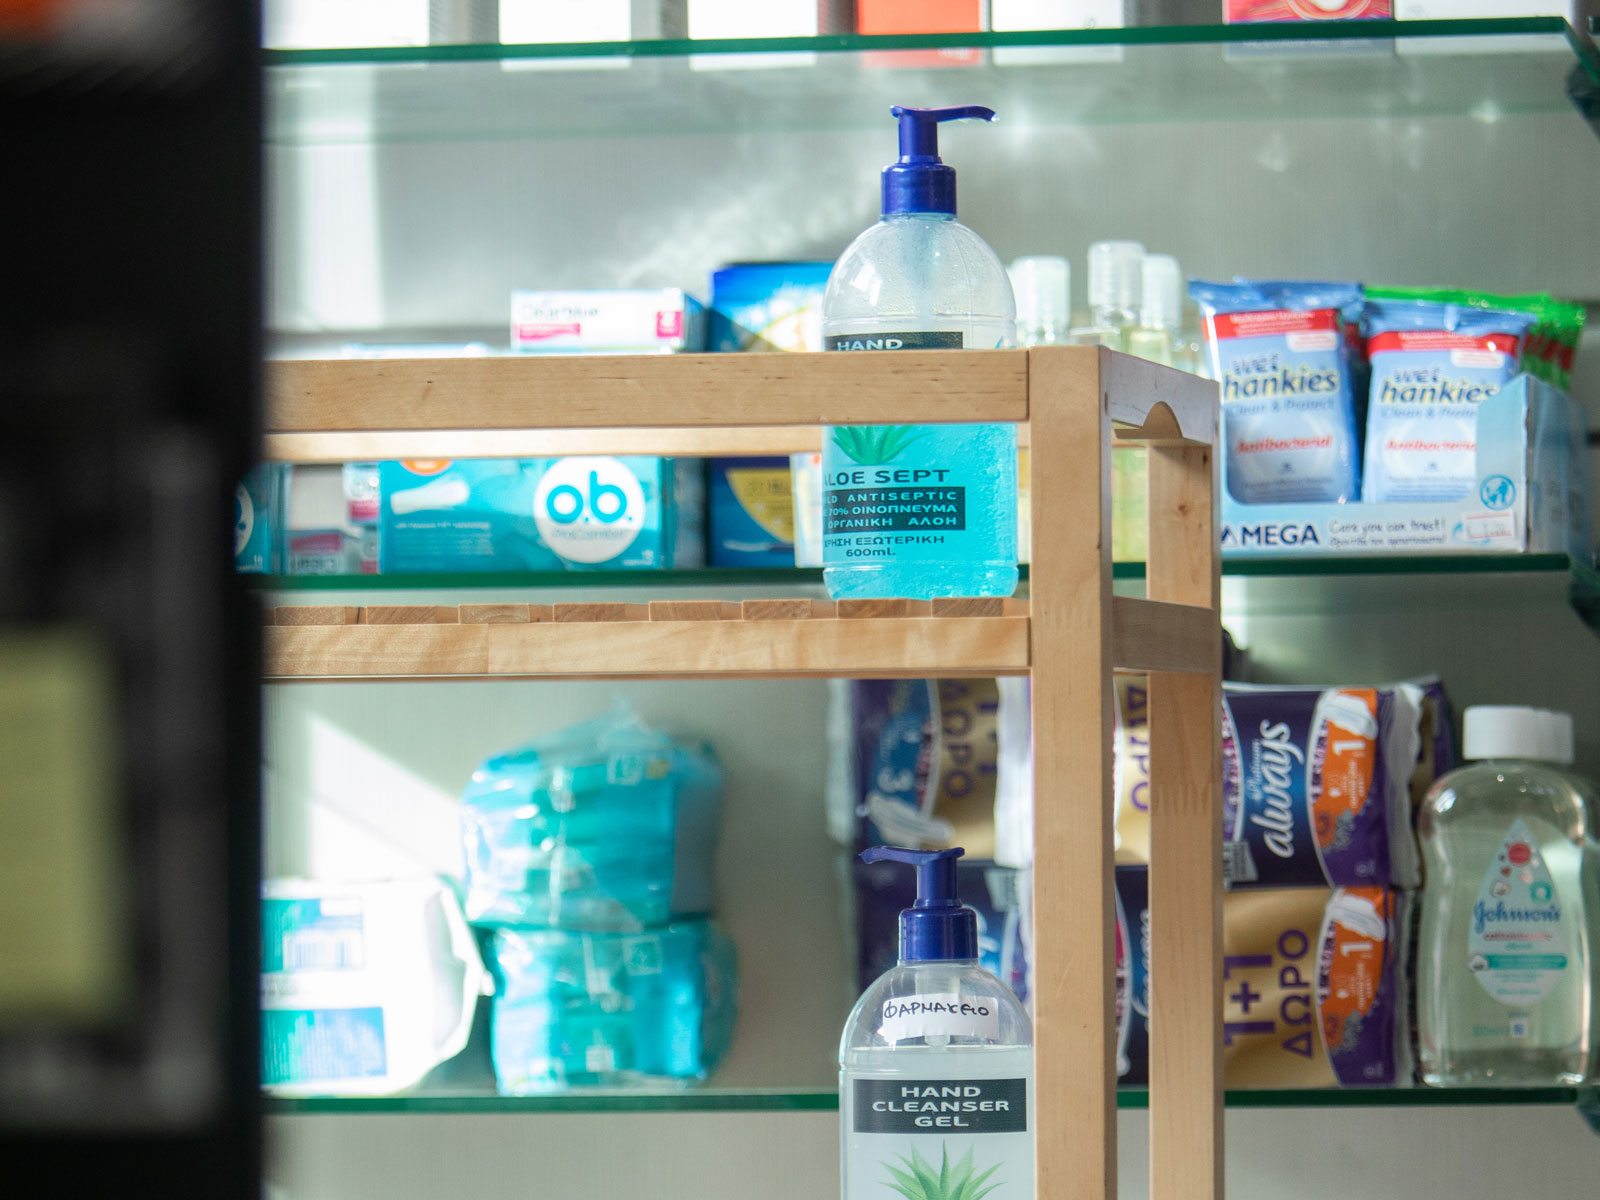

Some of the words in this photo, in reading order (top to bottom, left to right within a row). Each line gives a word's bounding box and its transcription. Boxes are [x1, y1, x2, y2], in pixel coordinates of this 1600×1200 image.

[837, 338, 904, 351] HAND
[1224, 369, 1338, 398] hankies
[874, 470, 950, 484] SEPT
[847, 492, 957, 503] ANTISEPTIC
[852, 504, 957, 515] ΟΙΝΟΠΝΕΥΜΑ
[908, 516, 957, 526] ΑΛΟΗ
[856, 535, 945, 546] ΕΞΩΤΕΡΙΚΗ
[846, 547, 896, 557] 600ml.
[1251, 718, 1305, 859] always
[1224, 954, 1275, 1046] 1+1
[1277, 928, 1314, 1060] ΔΩΡΟ
[901, 1086, 981, 1098] HAND
[872, 1100, 1010, 1112] CLEANSER
[914, 1116, 969, 1127] GEL
